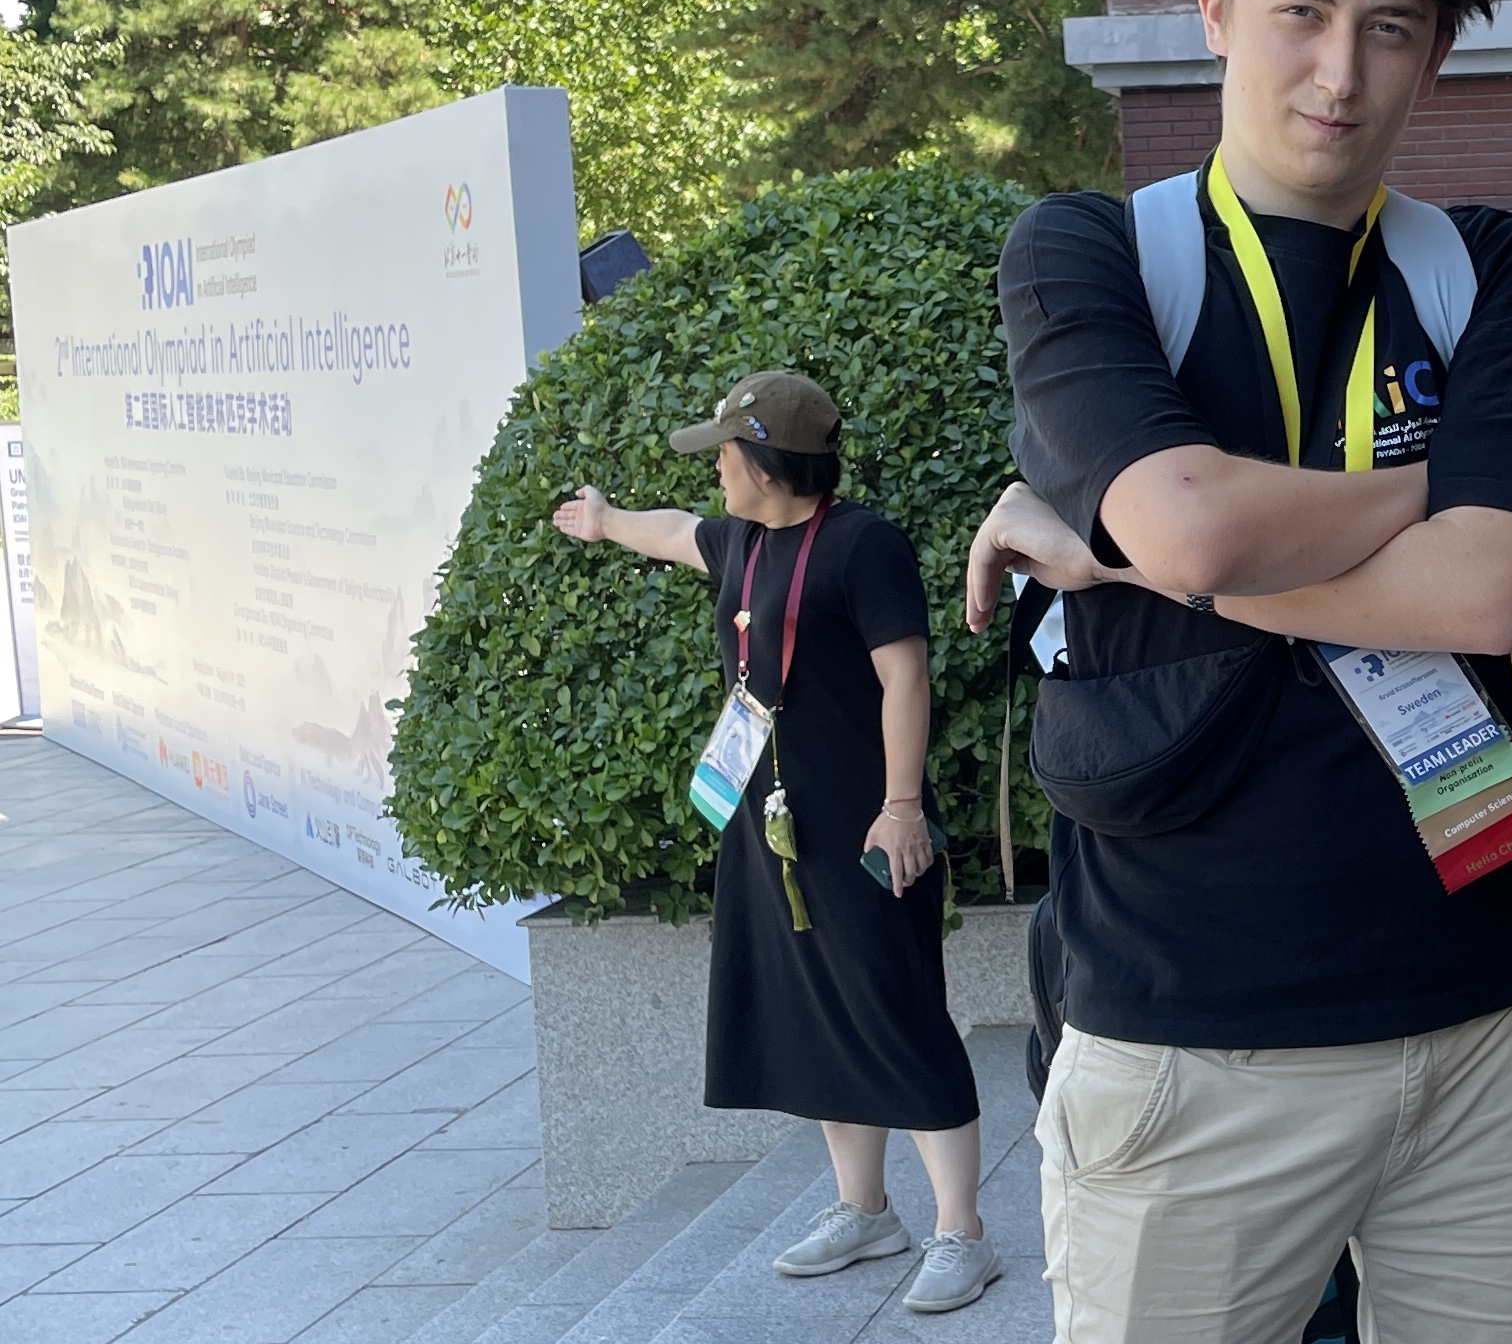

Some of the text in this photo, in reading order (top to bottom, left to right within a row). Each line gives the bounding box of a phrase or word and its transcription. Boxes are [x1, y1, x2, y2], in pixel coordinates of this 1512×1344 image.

[155, 237, 194, 309] IOAI
[71, 330, 142, 376] International
[145, 323, 206, 387] Olympiad
[210, 324, 224, 374] in
[229, 316, 294, 373] Artificial
[300, 311, 410, 386] Intelligence
[1397, 689, 1442, 716] Sweden
[1404, 750, 1447, 780] TEAM
[1445, 724, 1500, 759] LEADER
[1437, 764, 1494, 795] Organisation
[1439, 756, 1484, 782] Non-profit
[1444, 807, 1488, 838] Computer
[1465, 852, 1497, 874] Hello
